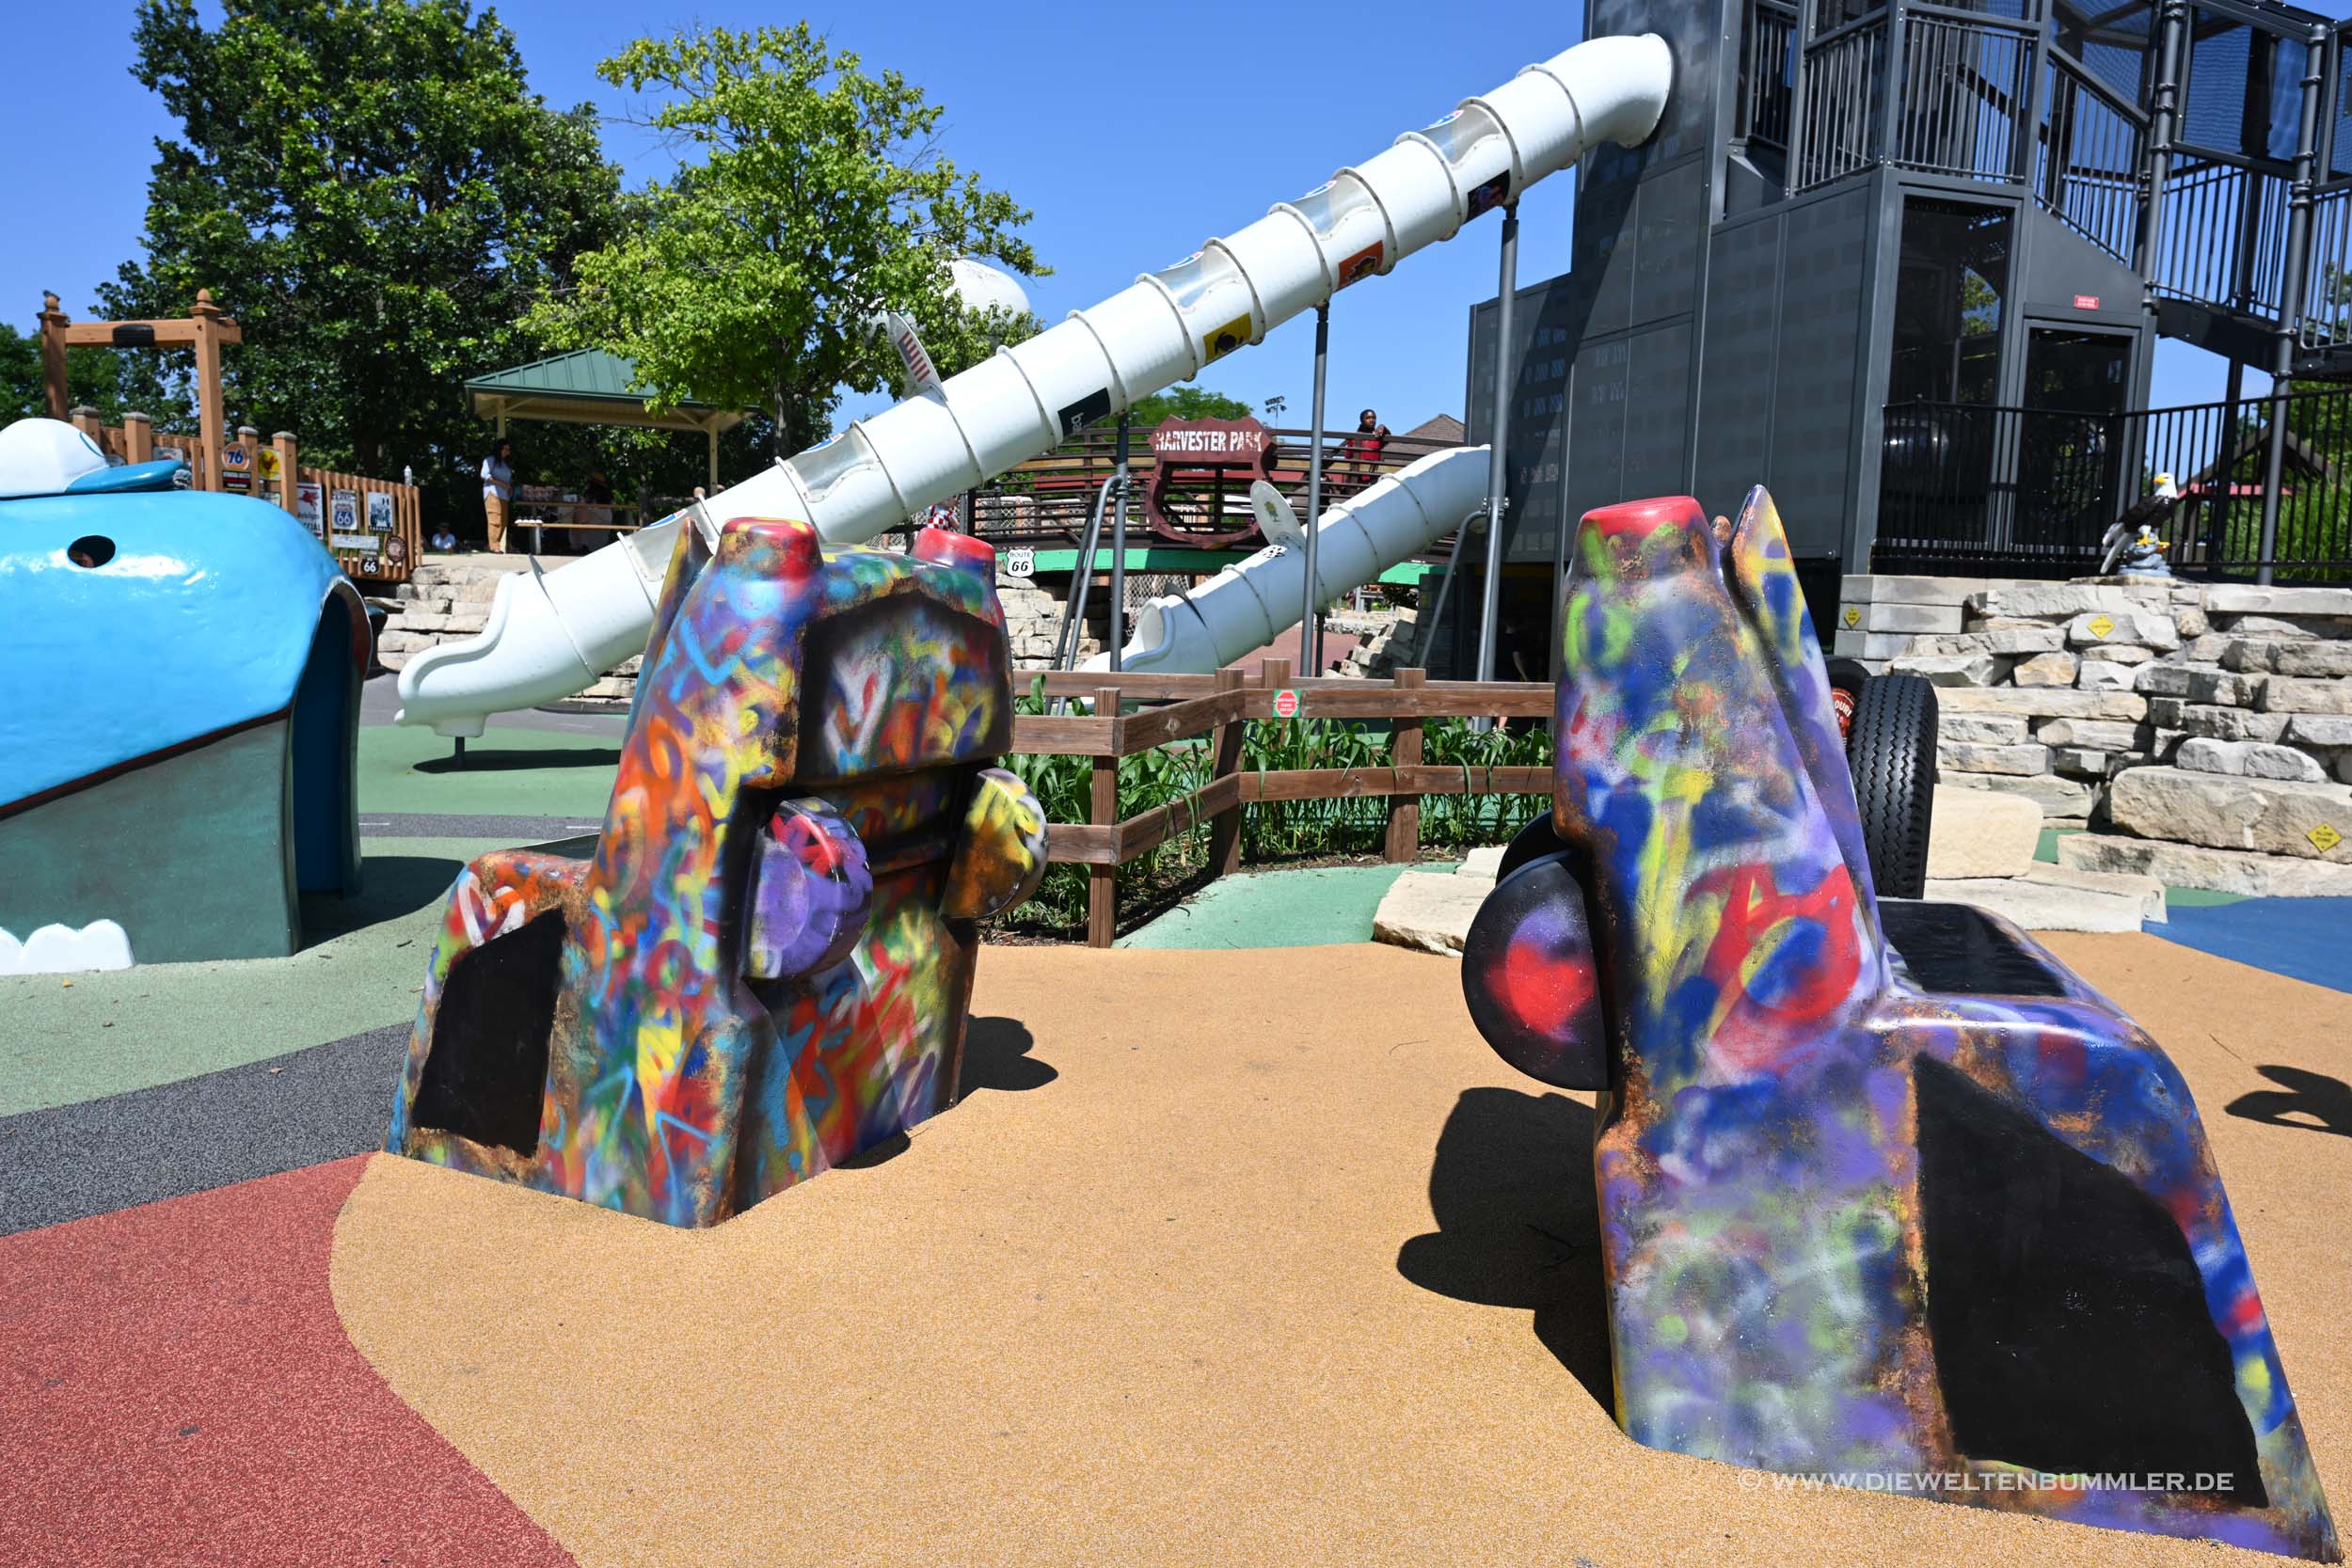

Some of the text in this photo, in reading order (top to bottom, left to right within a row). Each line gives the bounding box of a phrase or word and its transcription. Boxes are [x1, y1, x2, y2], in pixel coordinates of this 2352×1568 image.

[1155, 430, 1227, 451] HARVESTER
[227, 450, 245, 465] 76
[338, 512, 351, 525] 66
[363, 562, 376, 573] 66
[1011, 561, 1029, 572] 66
